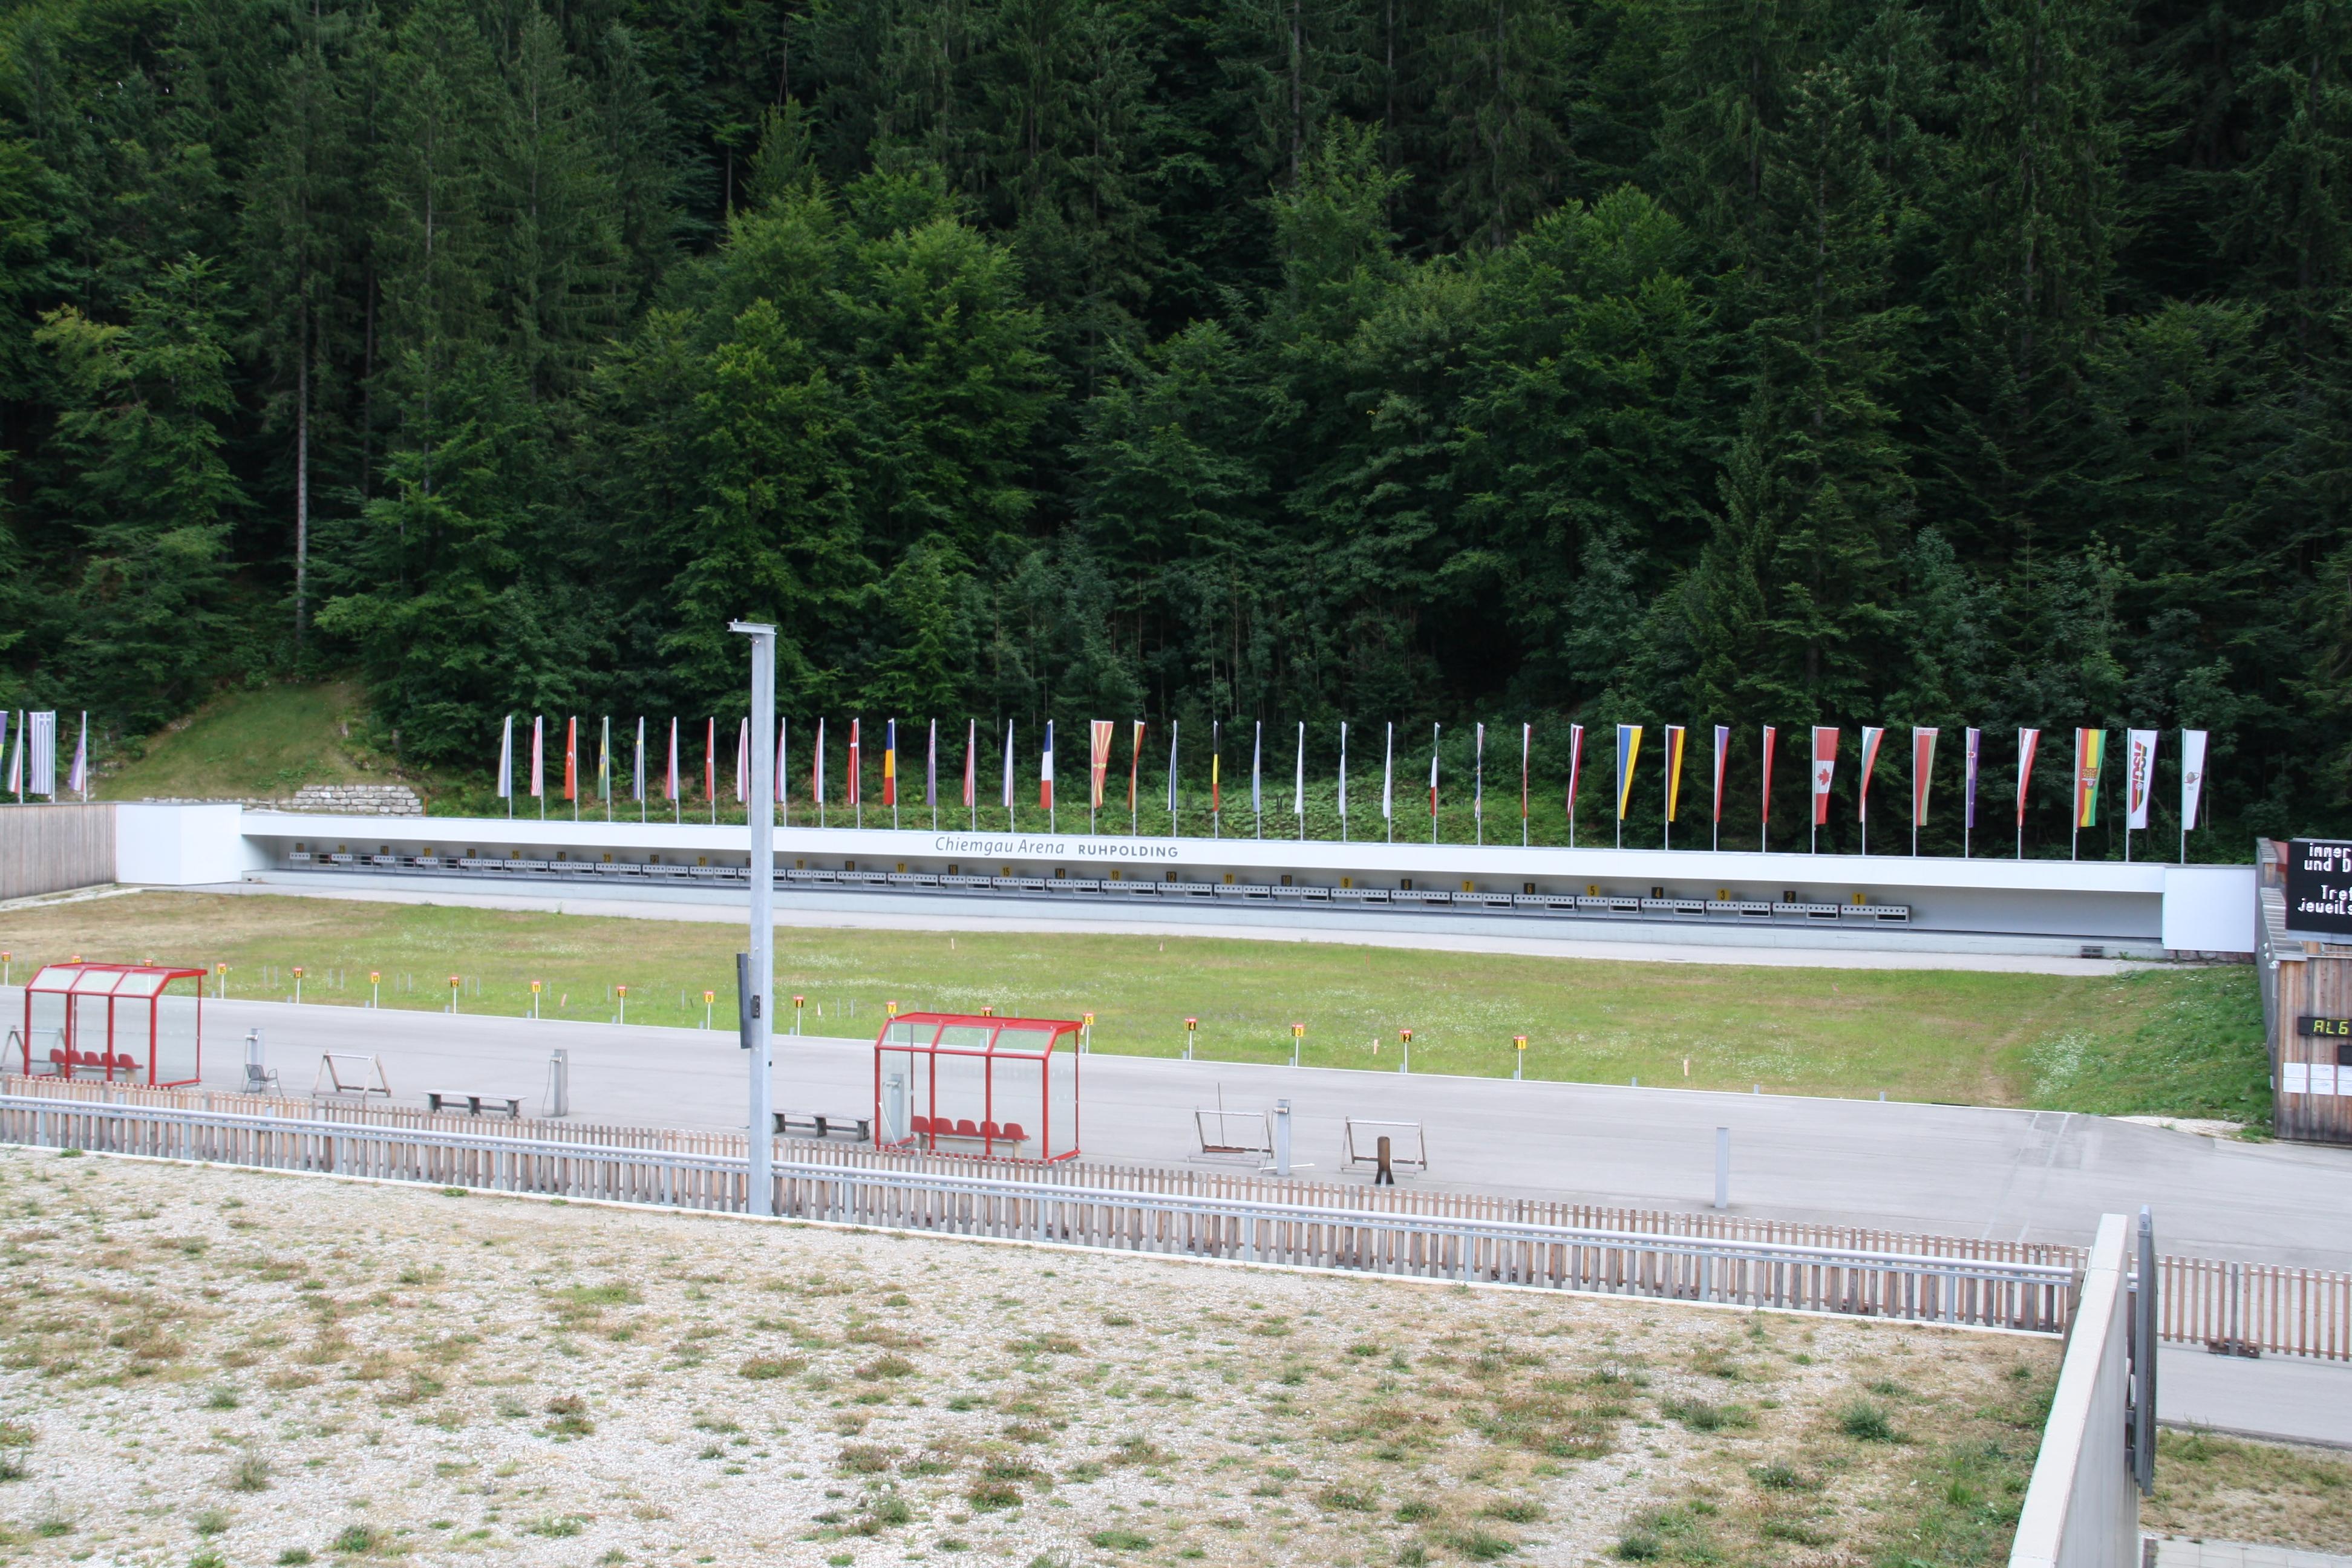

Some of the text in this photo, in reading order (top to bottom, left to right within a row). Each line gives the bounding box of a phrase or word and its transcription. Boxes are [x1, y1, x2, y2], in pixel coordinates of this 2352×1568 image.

[935, 836, 1178, 858] Chiemgau Arena RUHPOLDING
[2309, 843, 2351, 858] immer
[2304, 858, 2332, 872] und
